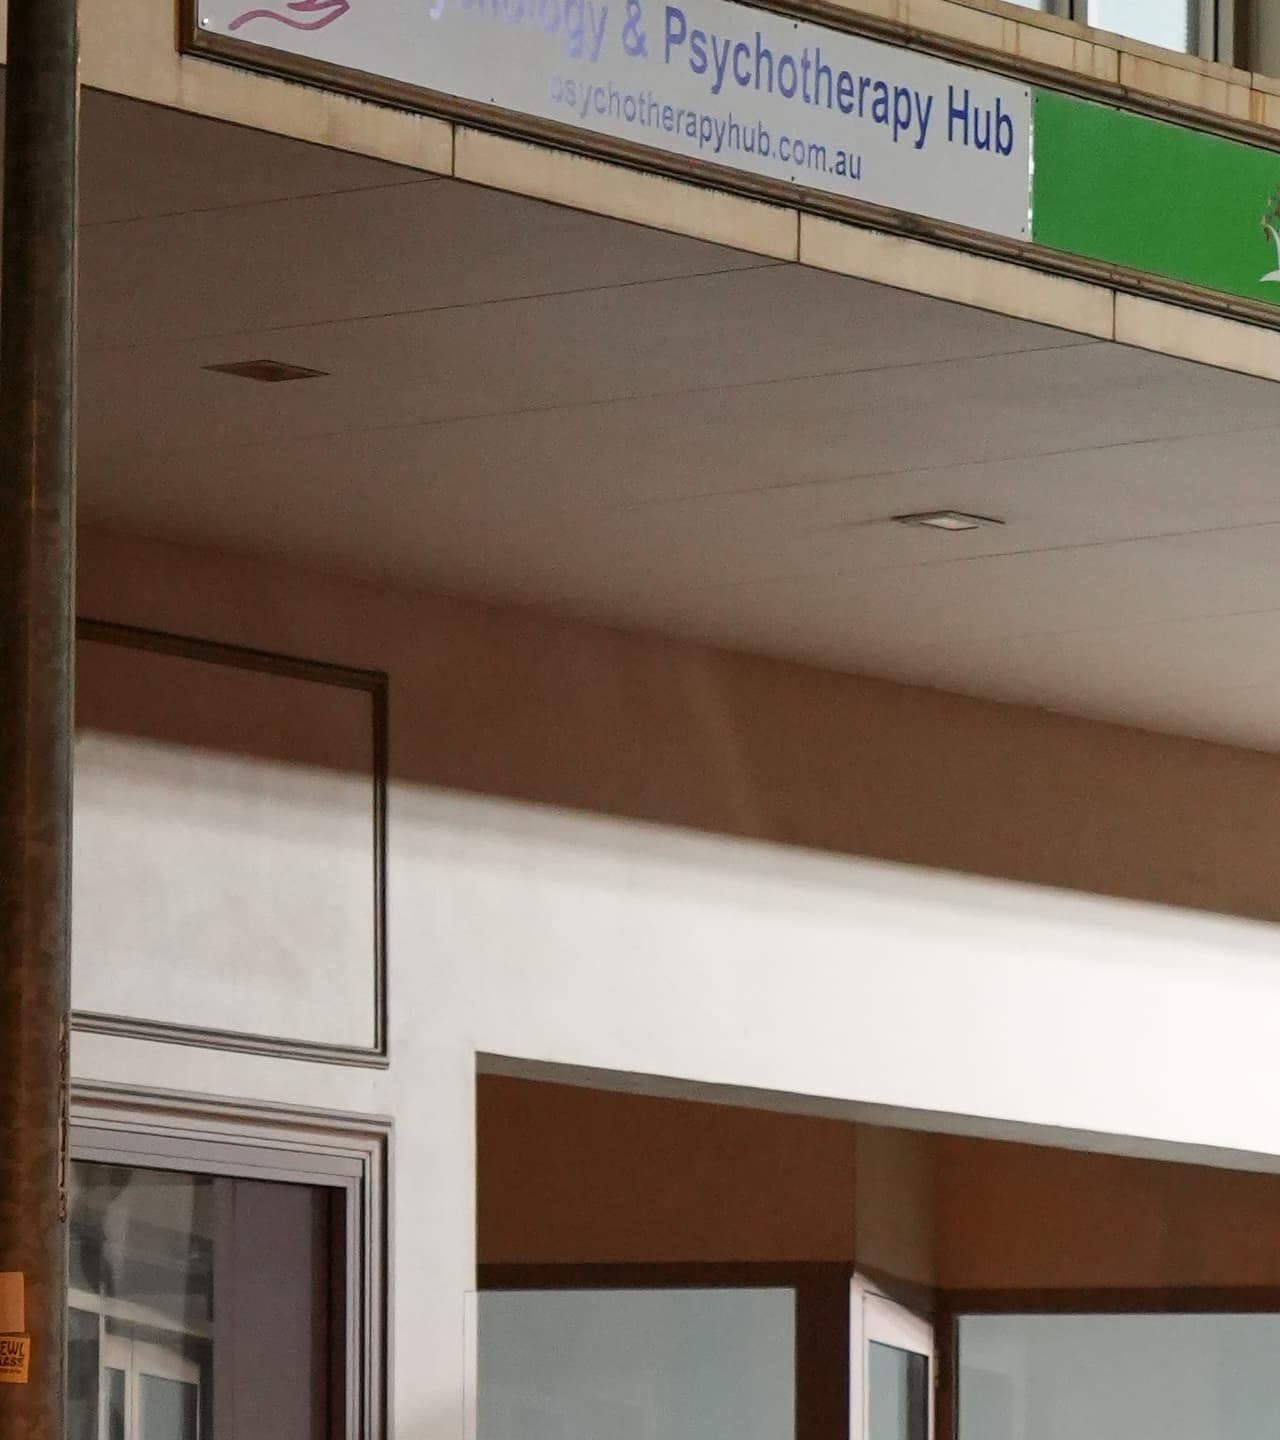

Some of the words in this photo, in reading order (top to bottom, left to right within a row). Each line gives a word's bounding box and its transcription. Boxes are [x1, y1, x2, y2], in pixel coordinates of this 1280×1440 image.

[549, 71, 863, 181] psychotherapyhub.com.au
[665, 6, 934, 150] Psychotherapy
[947, 84, 1014, 157] Hub
